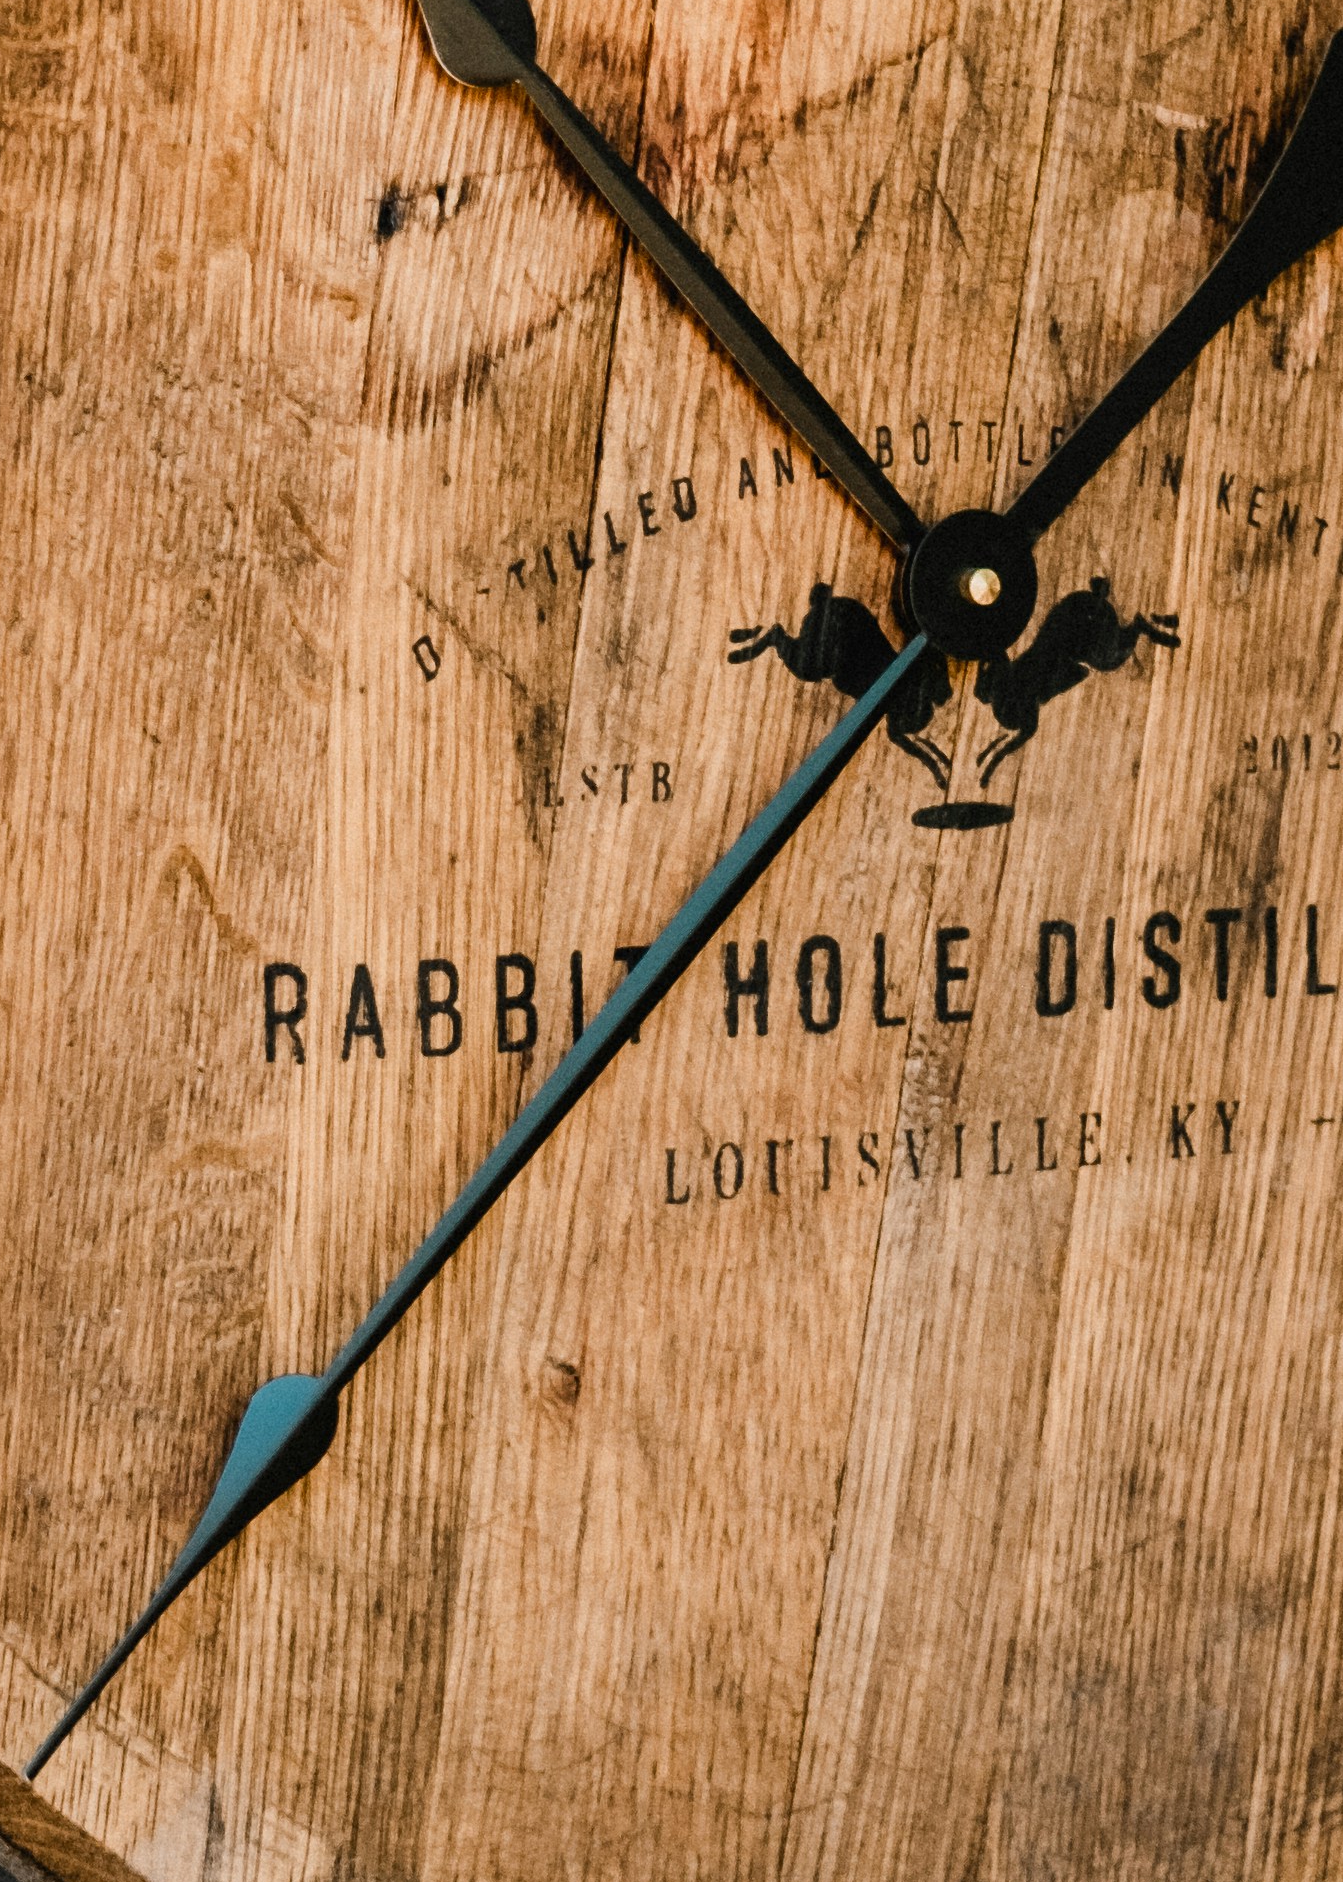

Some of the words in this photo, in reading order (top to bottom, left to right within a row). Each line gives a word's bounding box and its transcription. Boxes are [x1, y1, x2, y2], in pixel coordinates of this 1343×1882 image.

[412, 476, 698, 683] DTILLED
[1138, 445, 1184, 495] IN
[1242, 730, 1343, 774] 2012
[721, 923, 975, 1038] HOLE
[1169, 1099, 1242, 1158] KY
